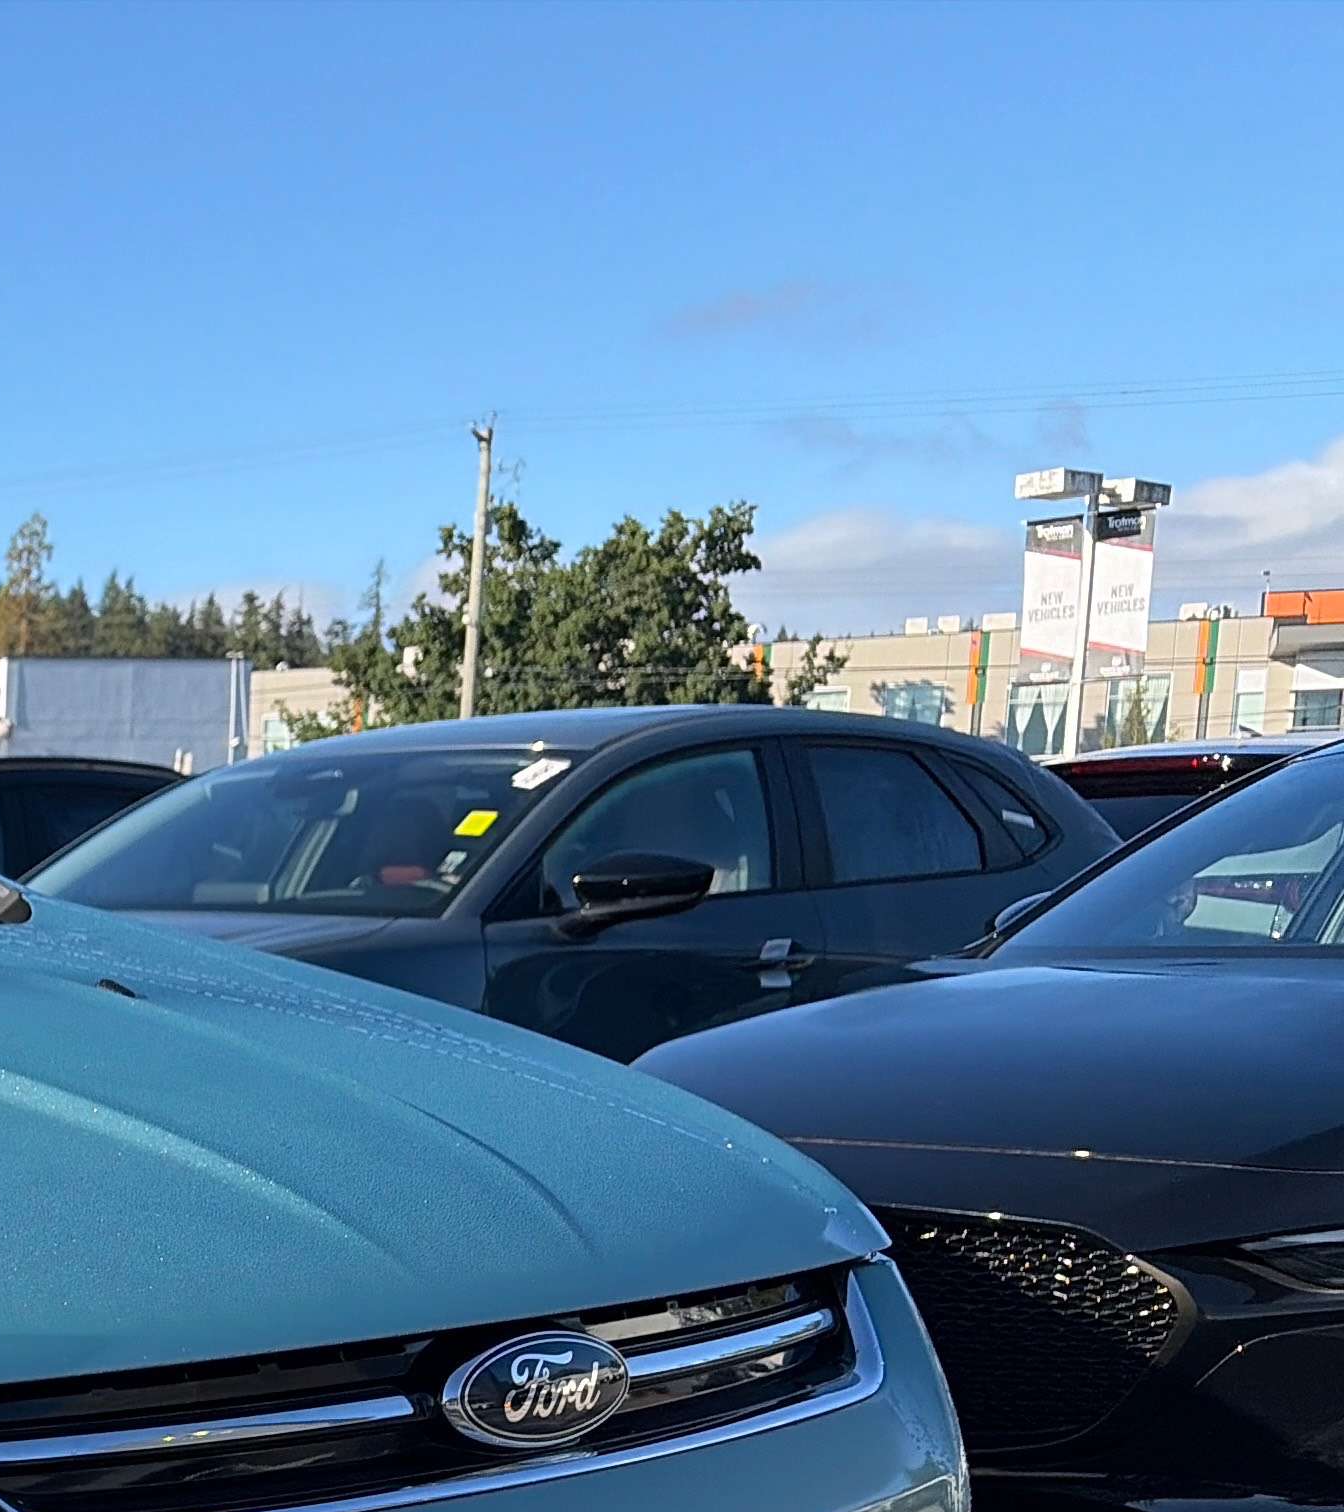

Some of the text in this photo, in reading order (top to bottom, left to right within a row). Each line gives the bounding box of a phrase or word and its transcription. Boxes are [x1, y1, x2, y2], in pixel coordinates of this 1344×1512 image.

[1040, 591, 1064, 606] NEW
[1111, 584, 1134, 599] NEW
[1028, 605, 1075, 622] VEHICLES
[1097, 598, 1146, 616] VEHICLES
[504, 1351, 601, 1423] Ford
